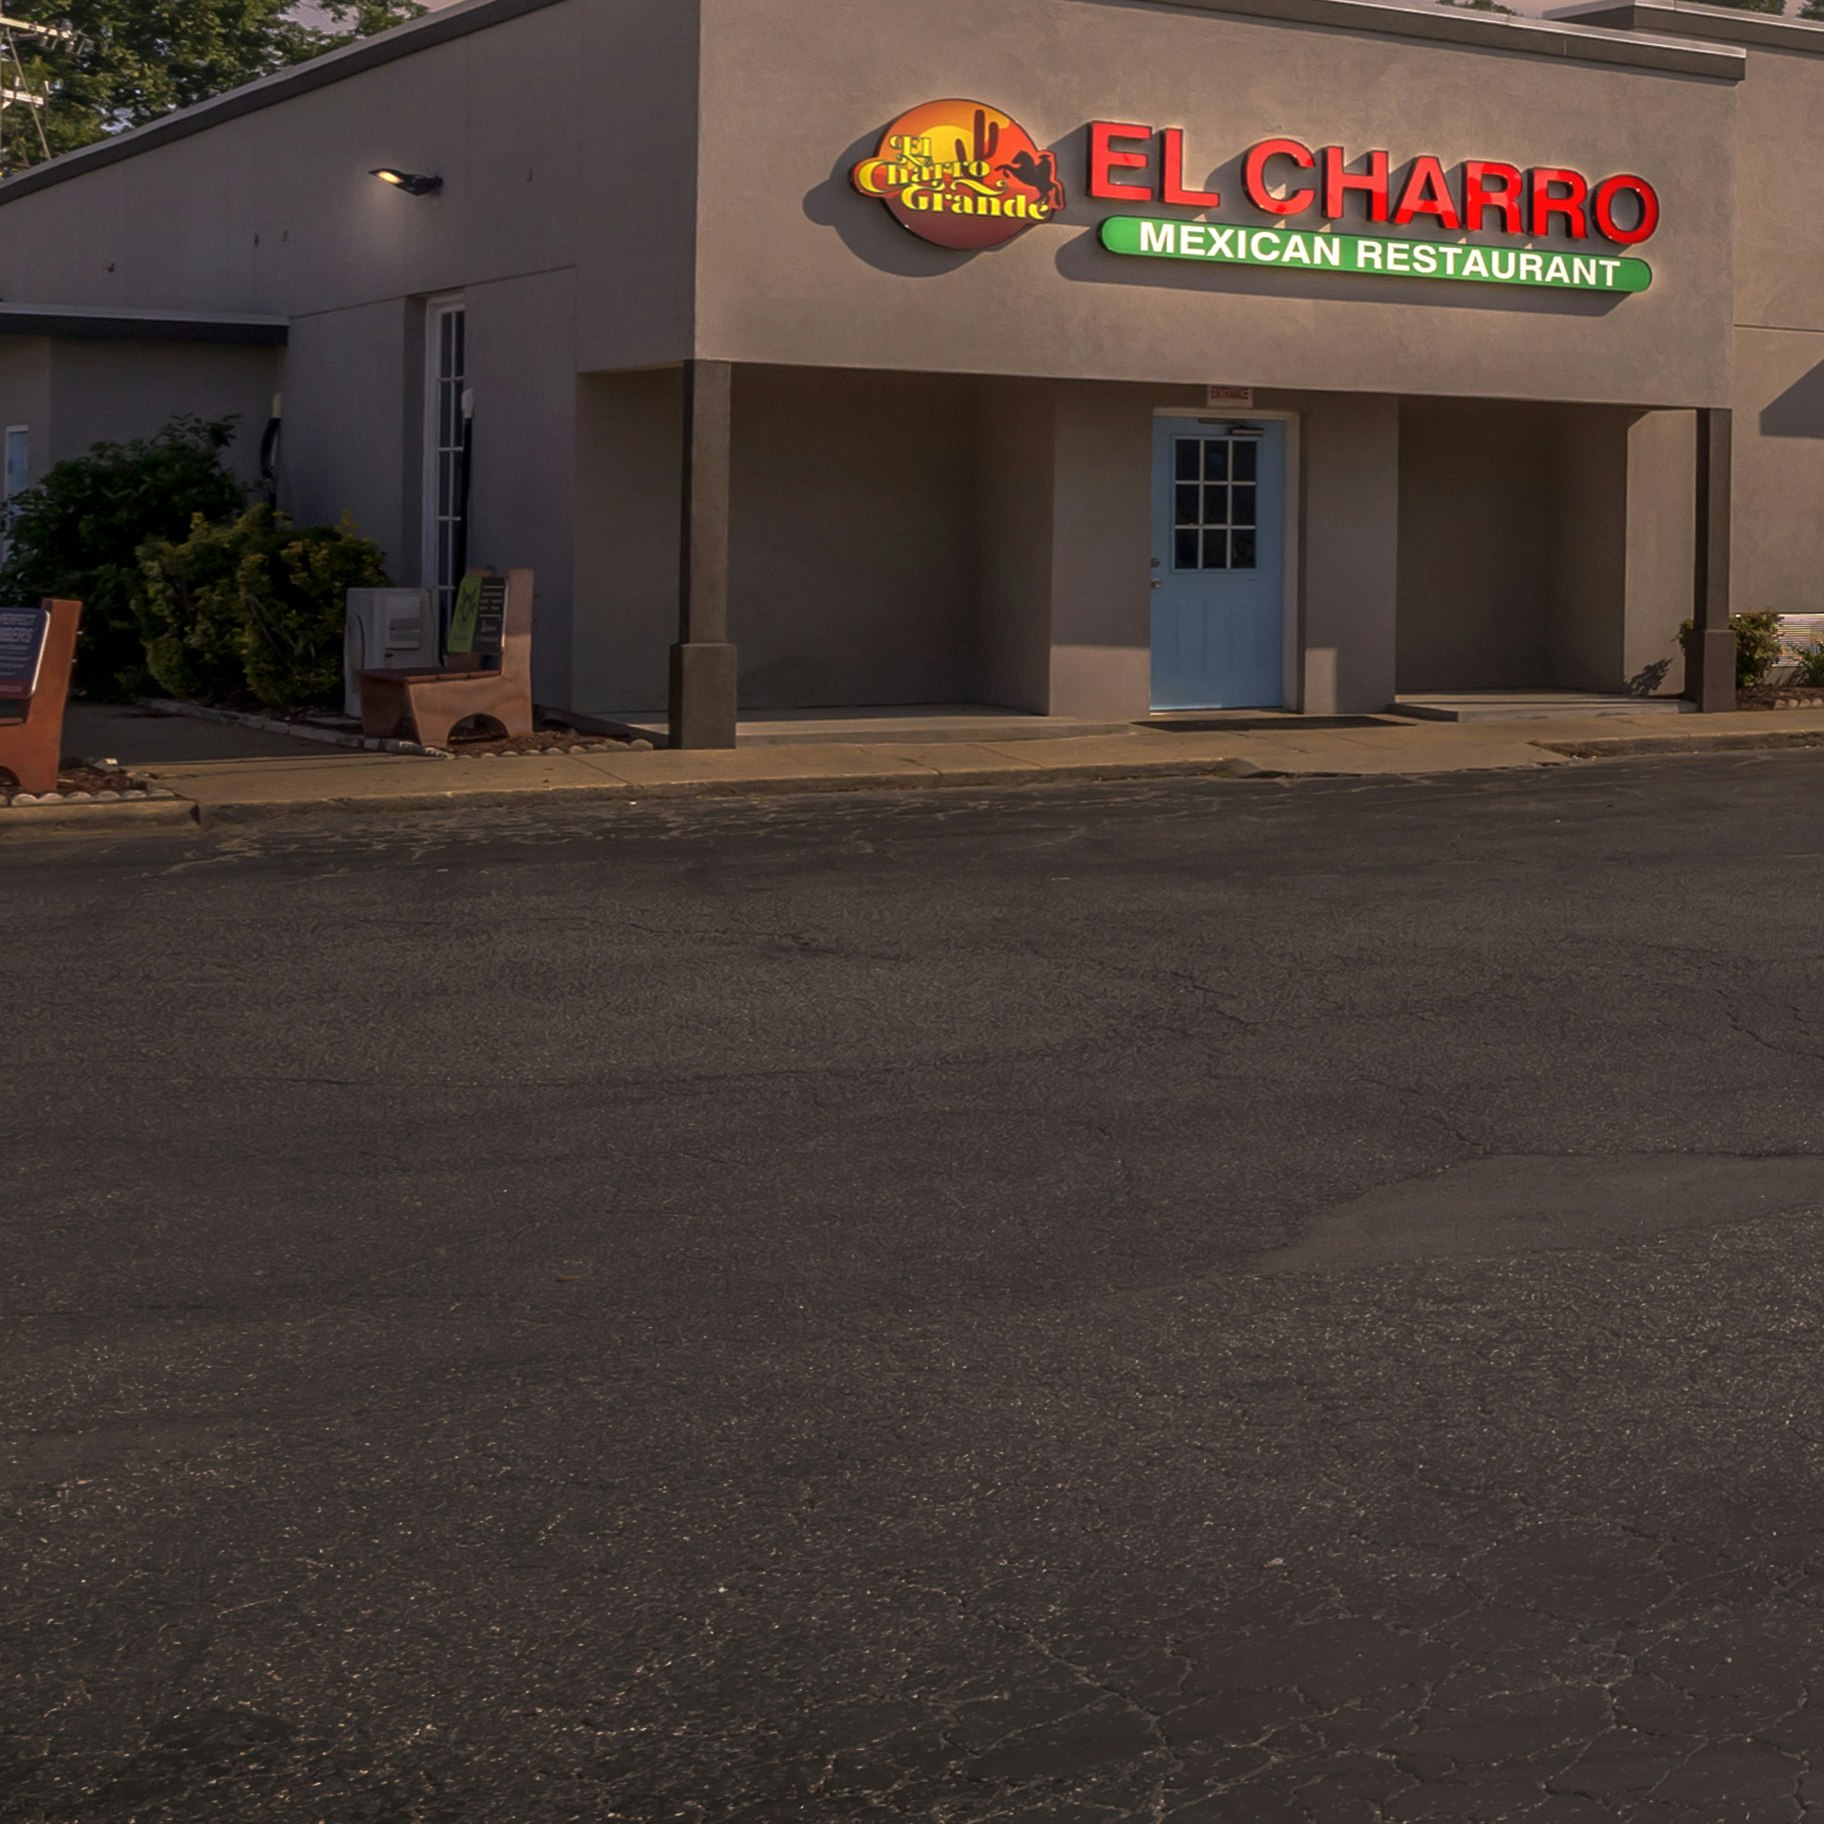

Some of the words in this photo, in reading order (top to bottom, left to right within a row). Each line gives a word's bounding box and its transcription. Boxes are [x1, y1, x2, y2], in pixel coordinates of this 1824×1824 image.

[889, 134, 932, 165] El
[858, 159, 991, 194] Charro
[1087, 119, 1220, 207] EL
[1242, 138, 1660, 245] CHARRO
[901, 180, 1050, 221] Grande
[1140, 221, 1341, 267] MEXICAN
[1356, 239, 1621, 287] RESTAURANT
